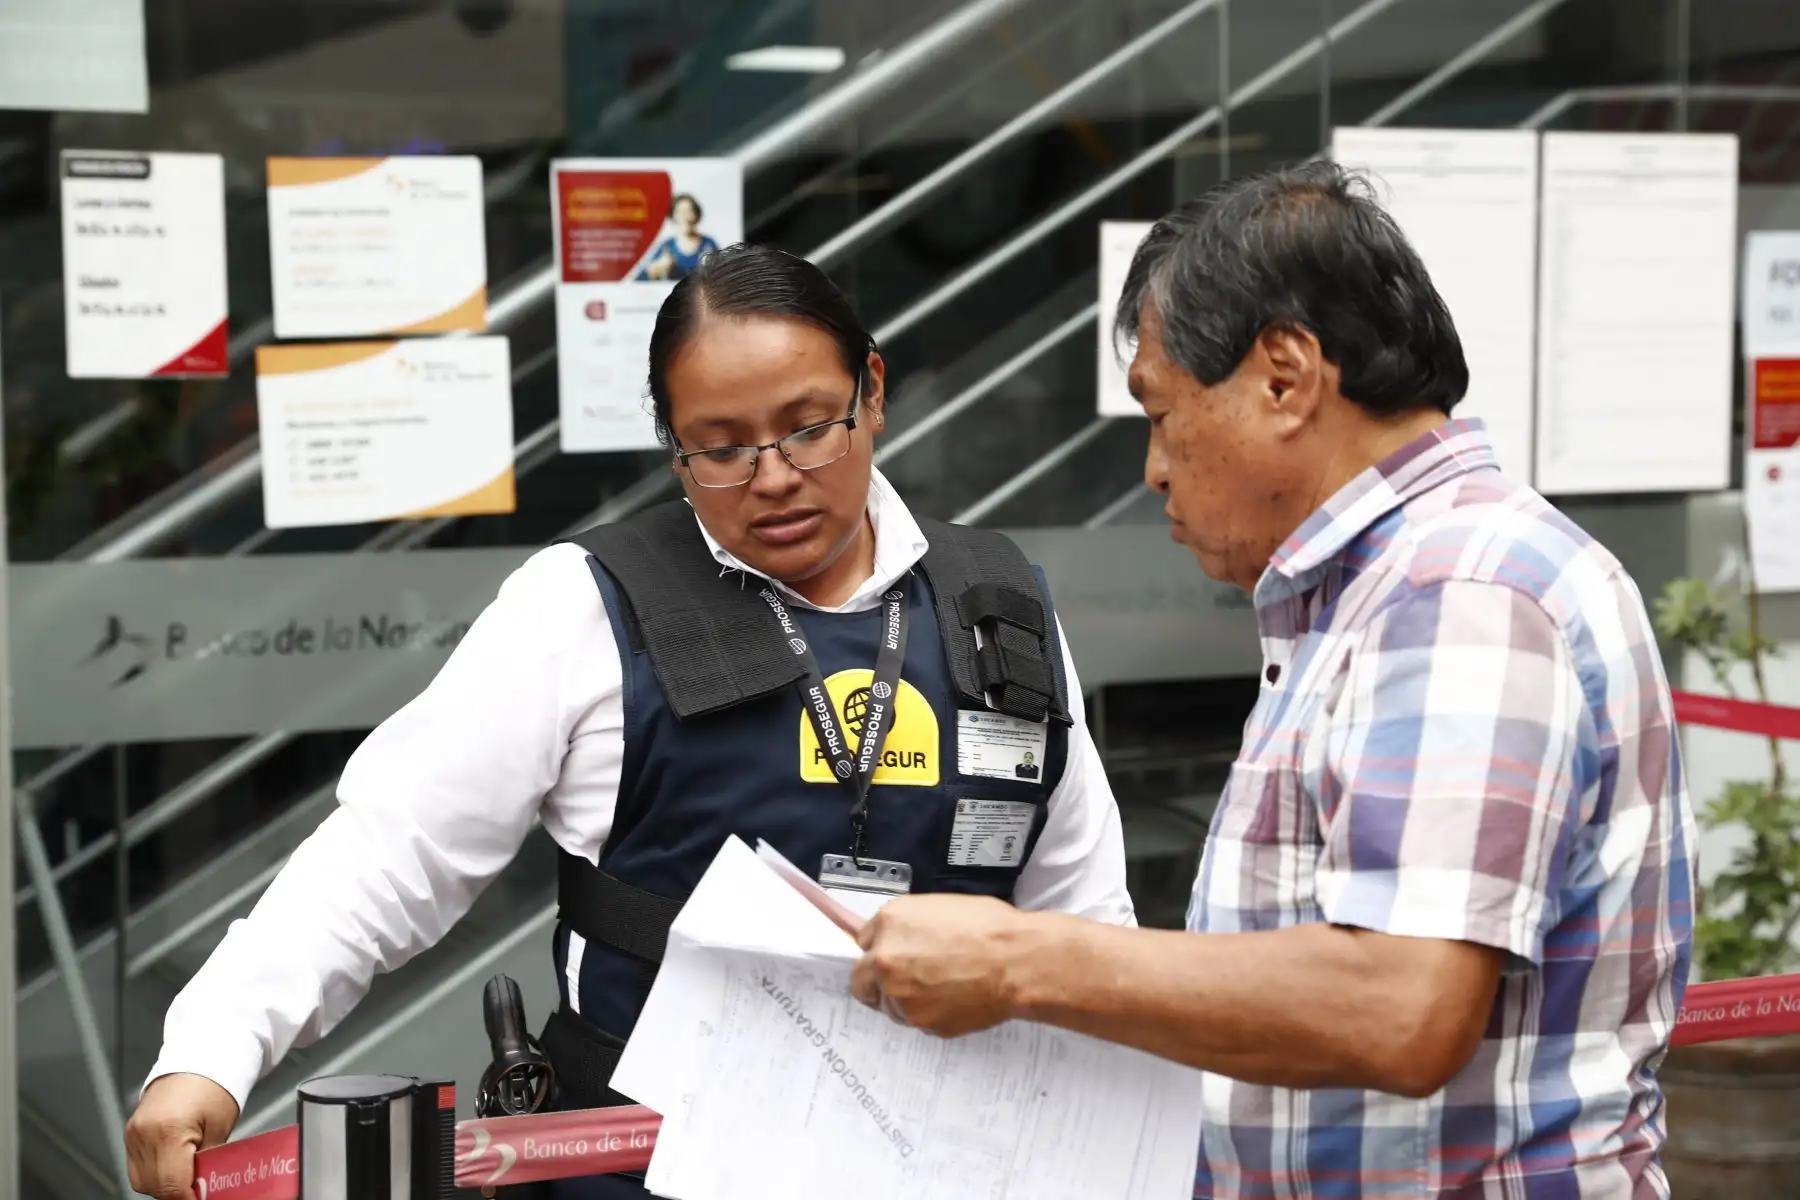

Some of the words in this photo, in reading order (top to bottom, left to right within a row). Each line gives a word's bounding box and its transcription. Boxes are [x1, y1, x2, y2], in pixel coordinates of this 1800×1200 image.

[759, 588, 796, 634] PROSEGUR
[886, 601, 900, 650] PROSEGUR
[809, 686, 842, 756] PROSEGUR
[858, 703, 884, 773] PROSEGUR
[814, 748, 927, 769] PGUR
[762, 976, 827, 1048] GRATUITA
[1676, 1006, 1725, 1025] Banco
[1731, 1000, 1751, 1019] de
[1756, 997, 1771, 1016] la
[822, 1047, 915, 1158] DISTRIBUCIÓN
[523, 1136, 588, 1160] Banco
[596, 1131, 622, 1153] de
[629, 1128, 648, 1149] la
[209, 1171, 241, 1193] Banco
[243, 1161, 257, 1185] de
[258, 1158, 269, 1181] la
